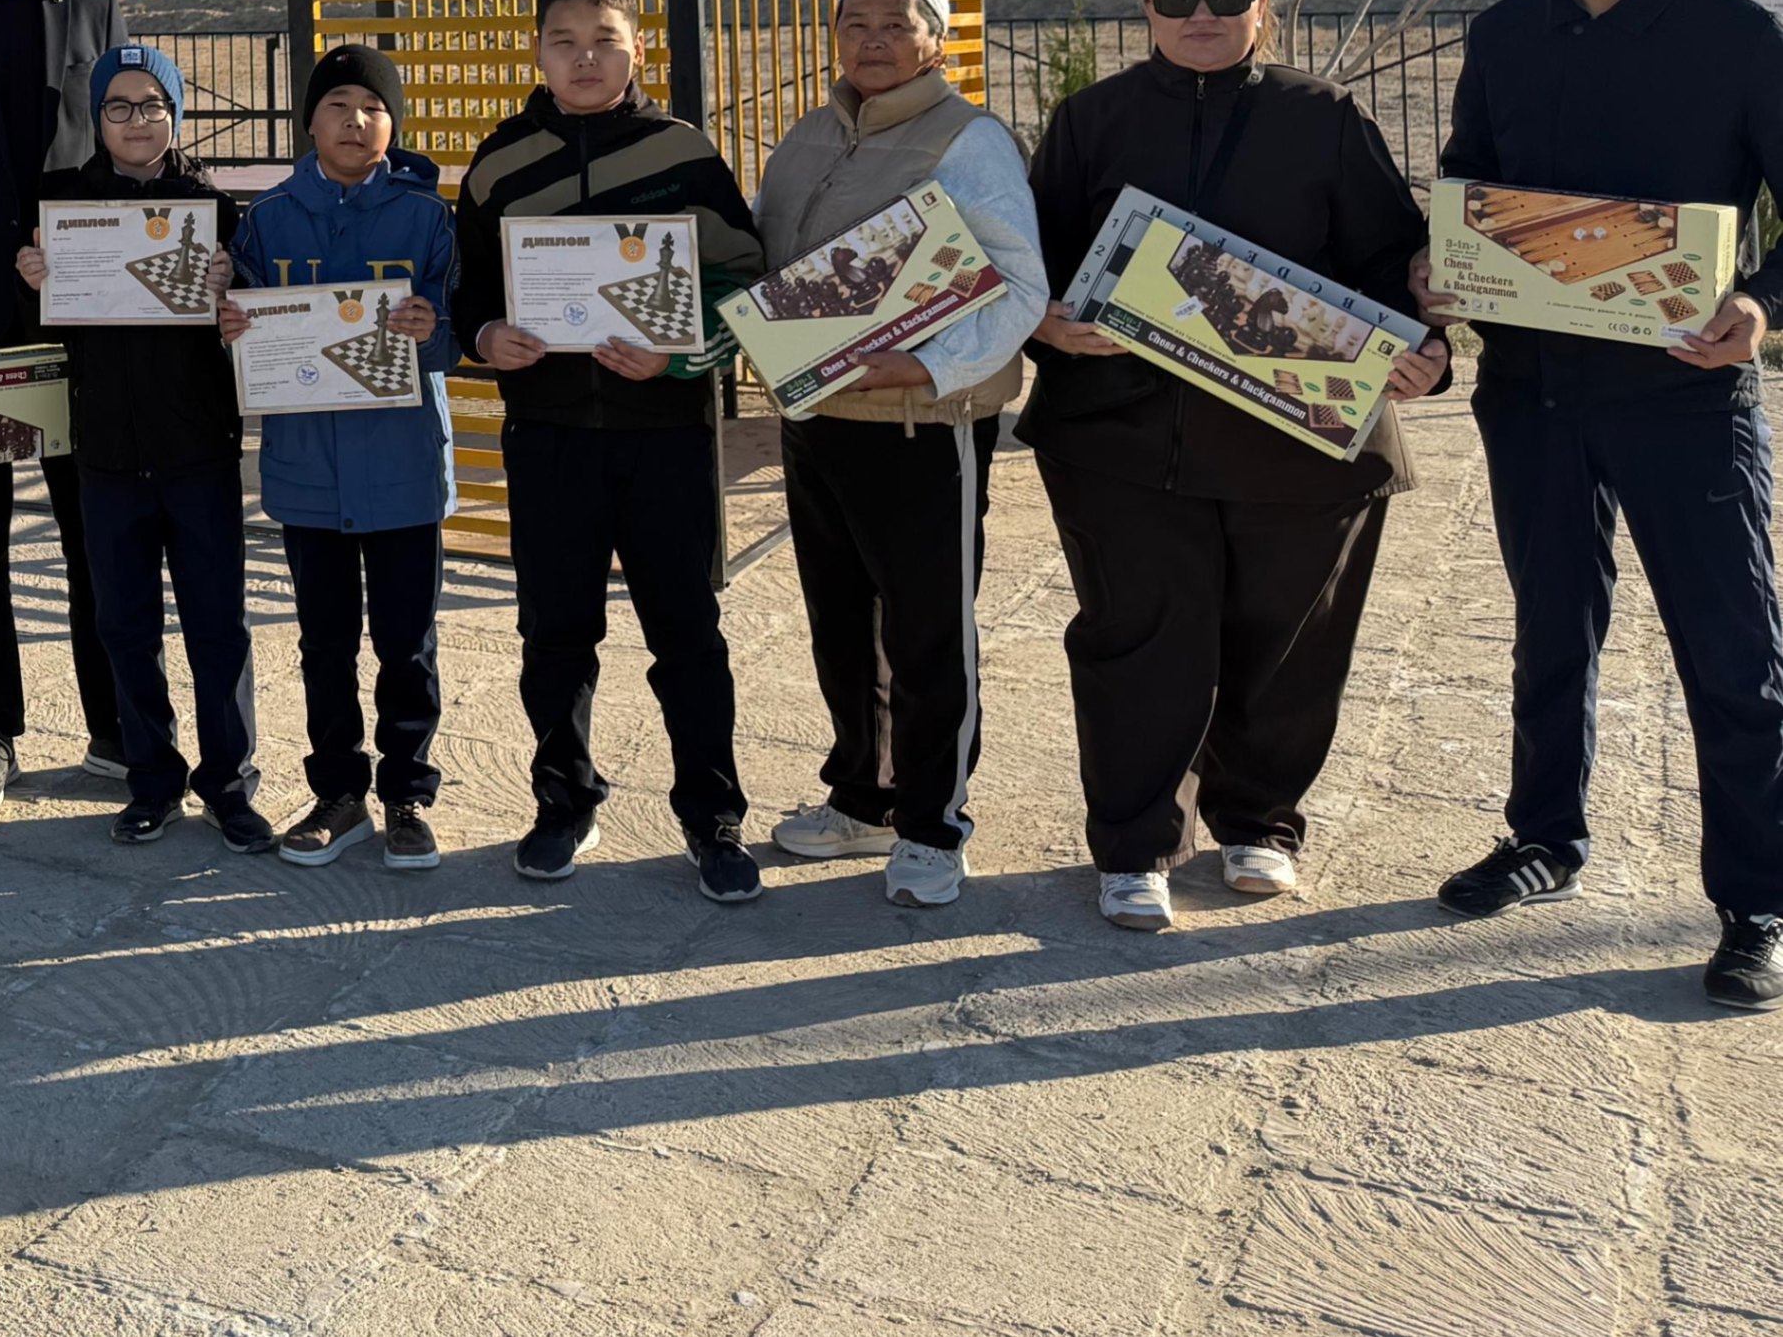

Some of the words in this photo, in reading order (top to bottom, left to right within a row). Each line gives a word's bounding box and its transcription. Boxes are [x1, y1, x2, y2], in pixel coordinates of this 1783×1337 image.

[631, 188, 667, 205] adidas
[1149, 205, 1164, 217] H
[57, 217, 120, 230] ДИПЛОМ
[1111, 218, 1119, 228] 1
[1182, 222, 1195, 235] G
[521, 236, 591, 249] ДИПЛОМ
[1445, 238, 1482, 252] 3-in-1
[1094, 245, 1105, 256] 2
[1247, 250, 1258, 263] E
[1444, 257, 1473, 270] Chess
[1080, 272, 1090, 283] 3
[1277, 266, 1291, 279] D
[1457, 271, 1465, 280] &
[1468, 272, 1514, 287] Checkers
[1308, 280, 1322, 294] C
[1443, 279, 1451, 289] &
[1453, 281, 1518, 298] Backgammon
[1342, 296, 1355, 309] B
[247, 303, 311, 319] ДИПЛОМ
[820, 358, 846, 378] Chess
[892, 326, 902, 336] &
[901, 294, 960, 332] Backgammon
[8, 371, 28, 381] Chess
[1148, 331, 1175, 352] Chess
[1176, 346, 1185, 357] &
[1186, 351, 1230, 380] Checkers
[1230, 374, 1239, 385] &
[1240, 379, 1307, 419] Backgammon
